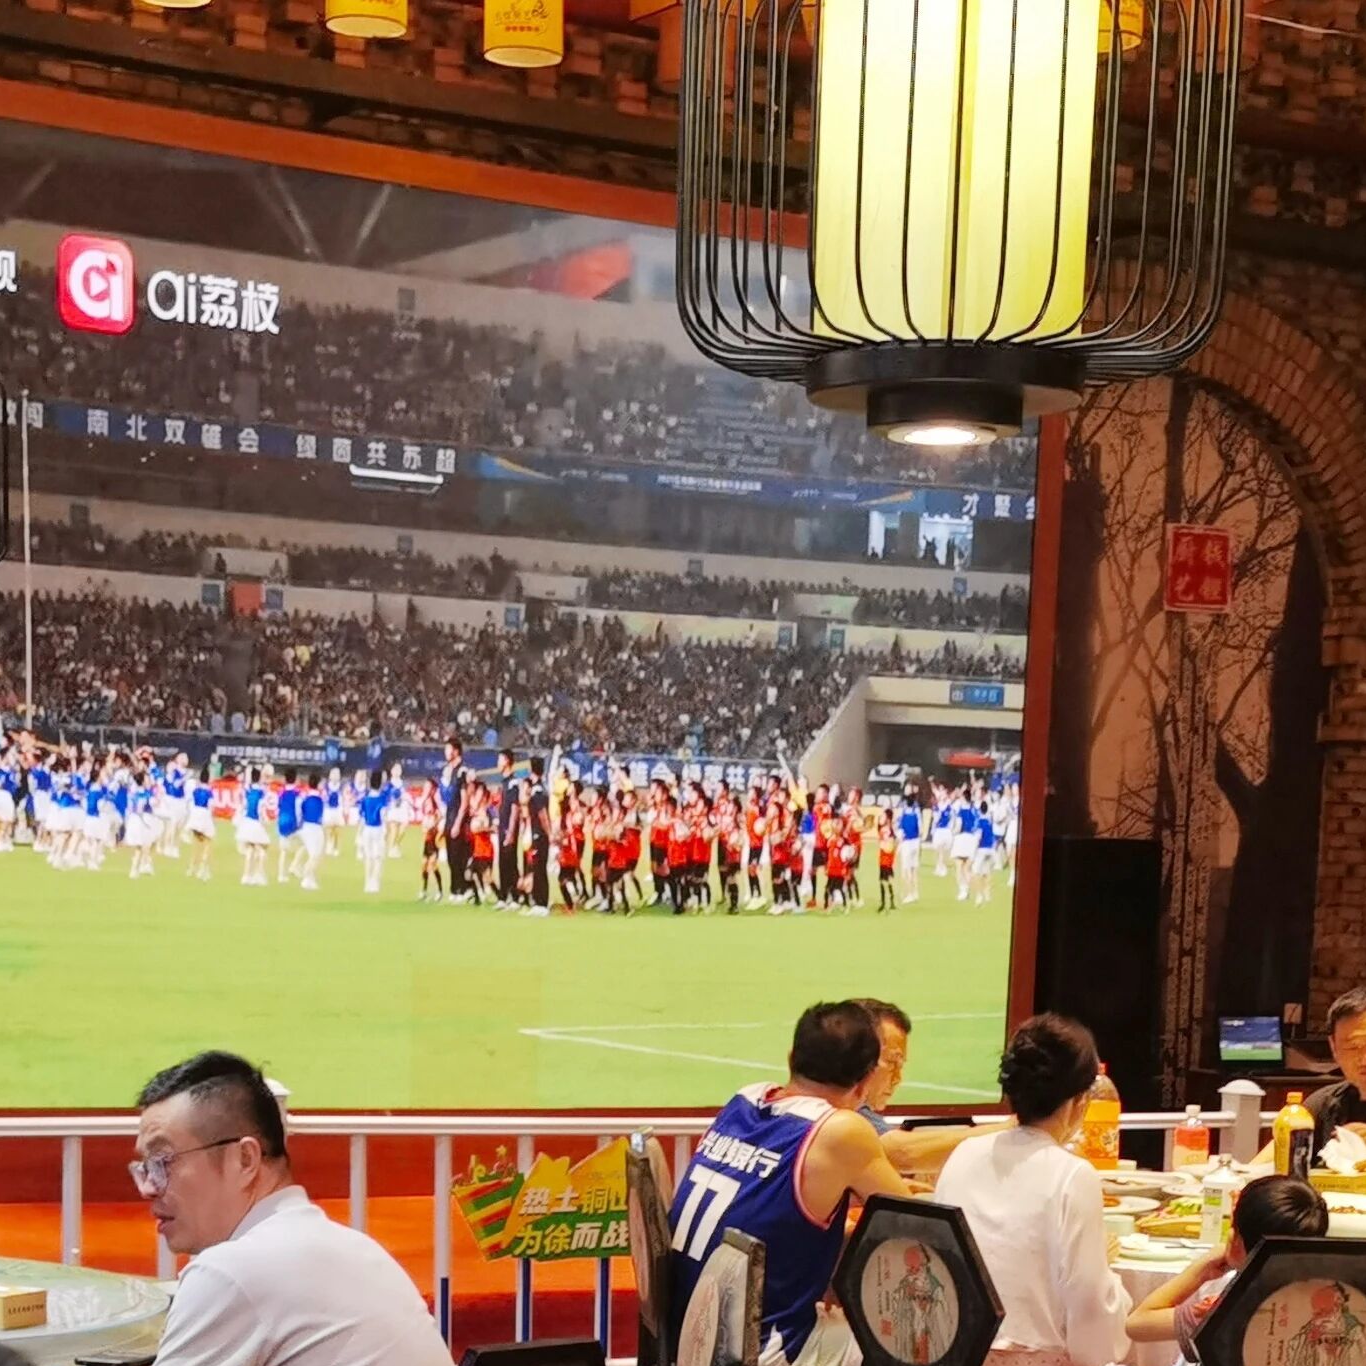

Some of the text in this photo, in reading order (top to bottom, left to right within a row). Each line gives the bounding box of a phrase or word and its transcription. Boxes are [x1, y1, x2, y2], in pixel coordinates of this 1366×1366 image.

[698, 1130, 782, 1179] 兴业银行
[519, 1185, 627, 1216] 热土铜山
[513, 1220, 630, 1255] 为徐而战
